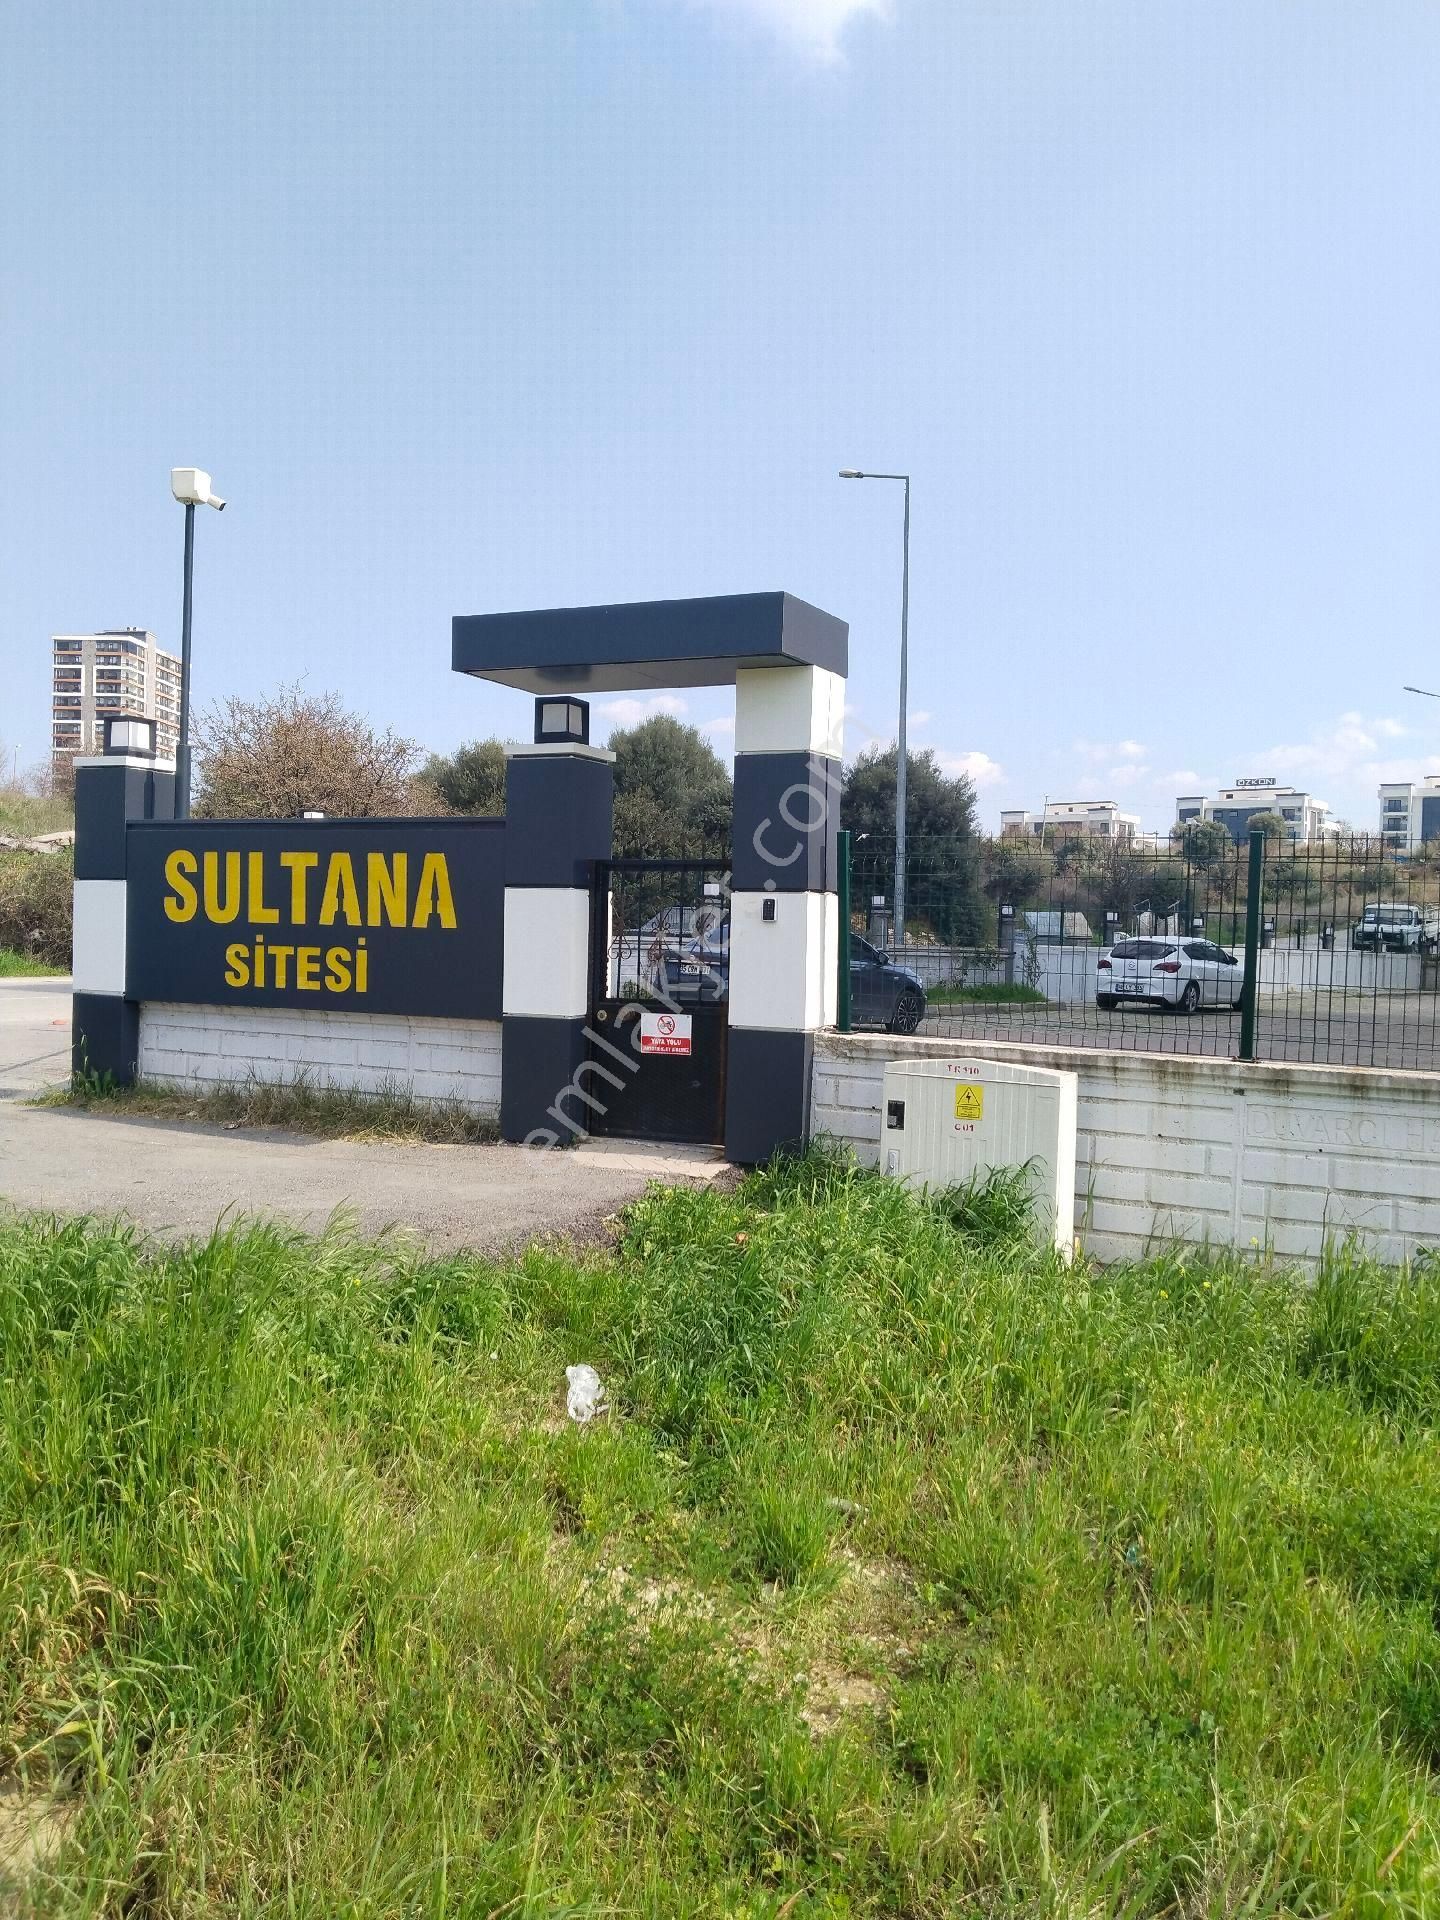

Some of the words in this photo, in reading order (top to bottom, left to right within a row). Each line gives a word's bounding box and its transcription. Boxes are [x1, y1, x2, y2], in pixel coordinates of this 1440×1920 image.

[163, 849, 458, 929] SULTANA
[224, 934, 368, 993] SİTESİ
[666, 1038, 682, 1046] YOLU
